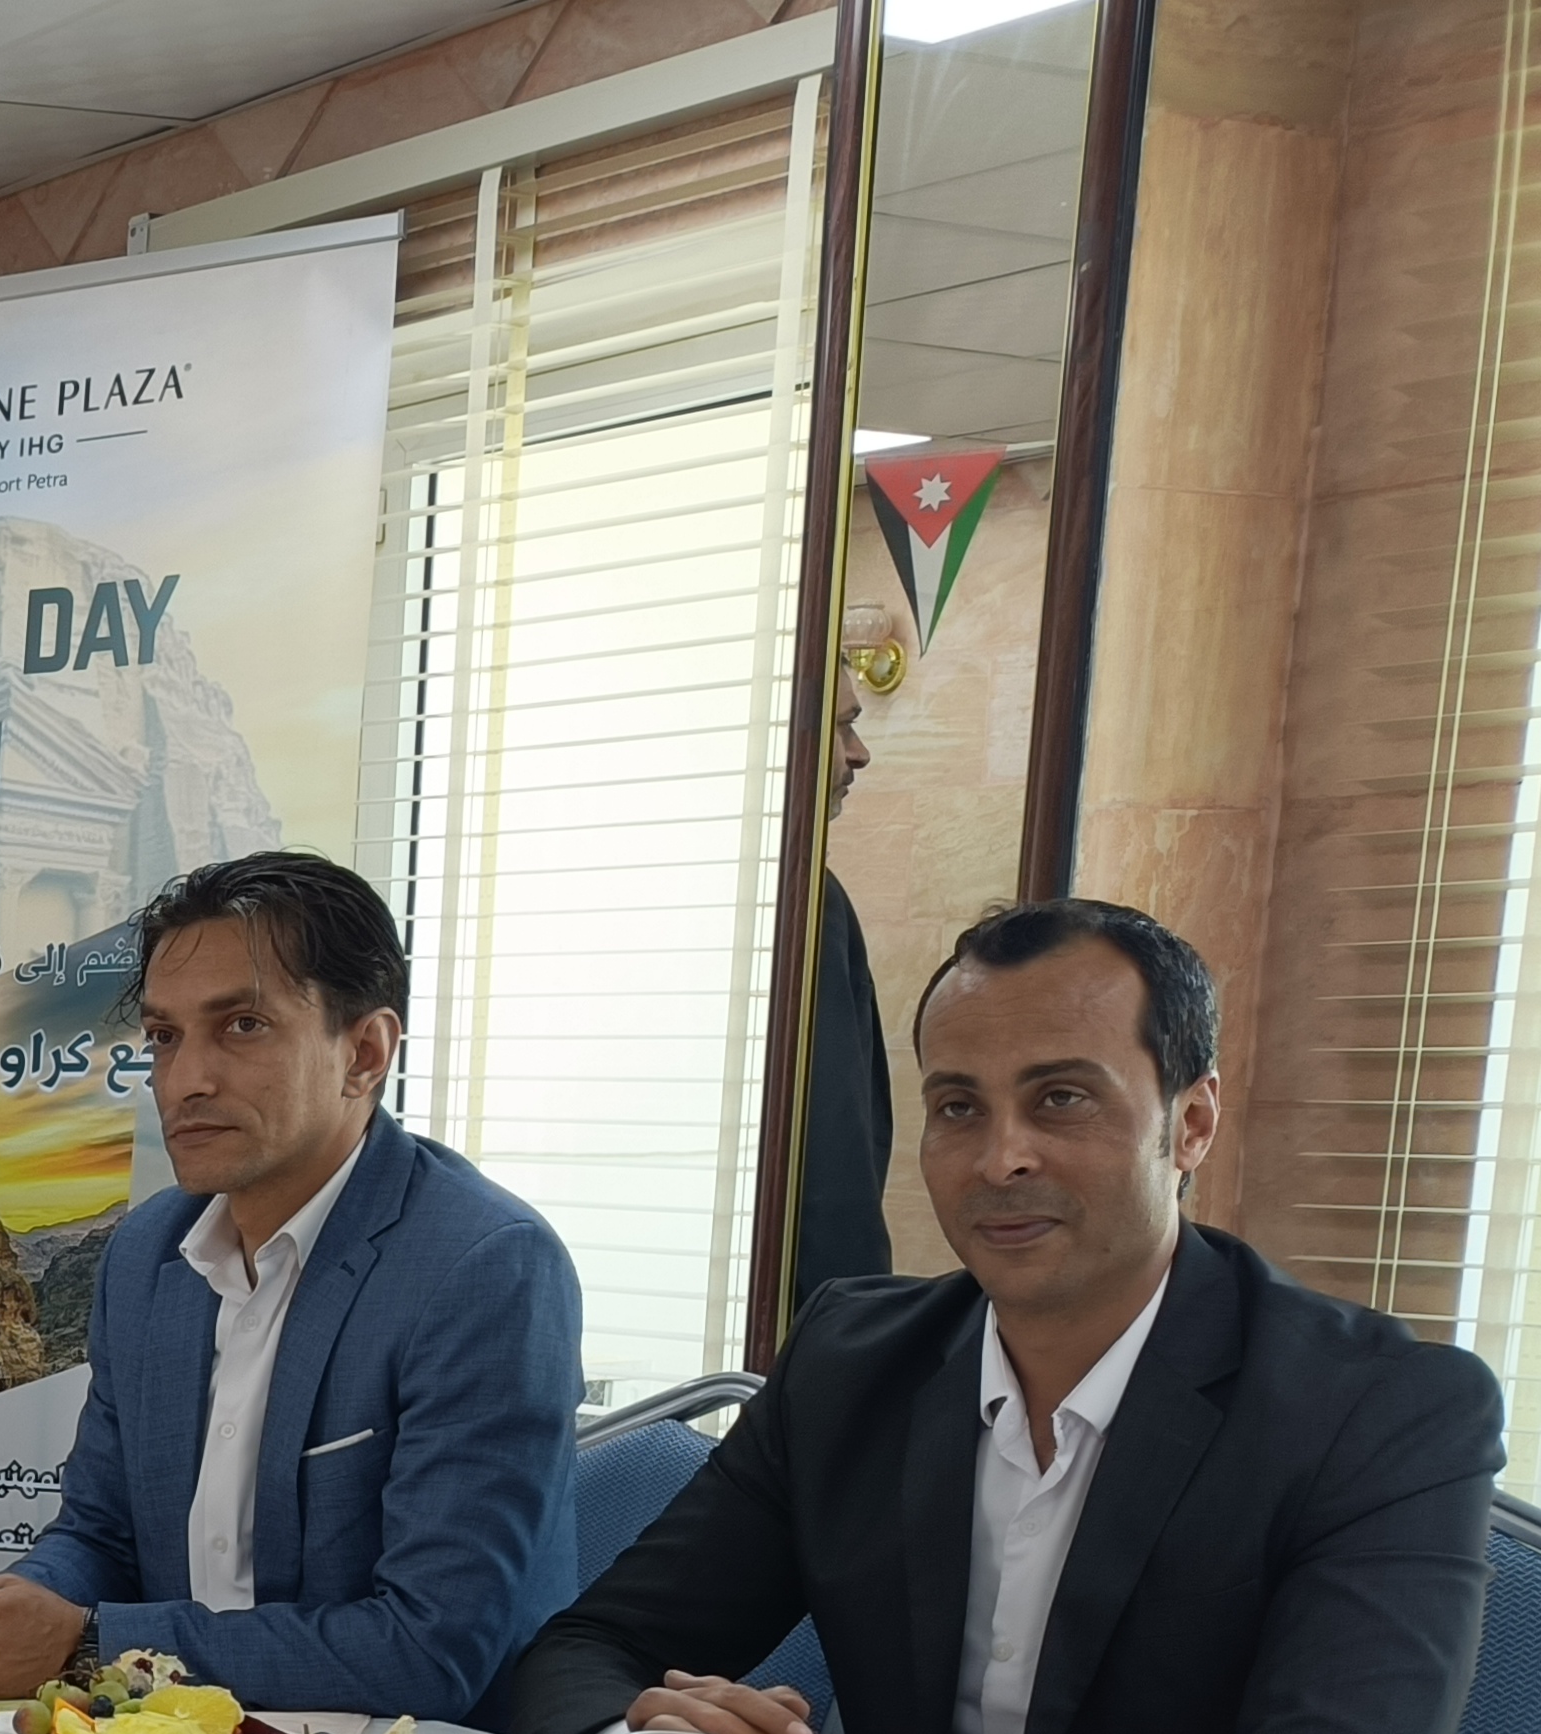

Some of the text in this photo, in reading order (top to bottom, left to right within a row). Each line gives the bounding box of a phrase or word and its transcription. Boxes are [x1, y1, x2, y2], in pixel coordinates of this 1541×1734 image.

[19, 433, 65, 458] IHG
[27, 473, 68, 491] Petra
[23, 574, 181, 675] DAY
[14, 941, 67, 987] إلى
